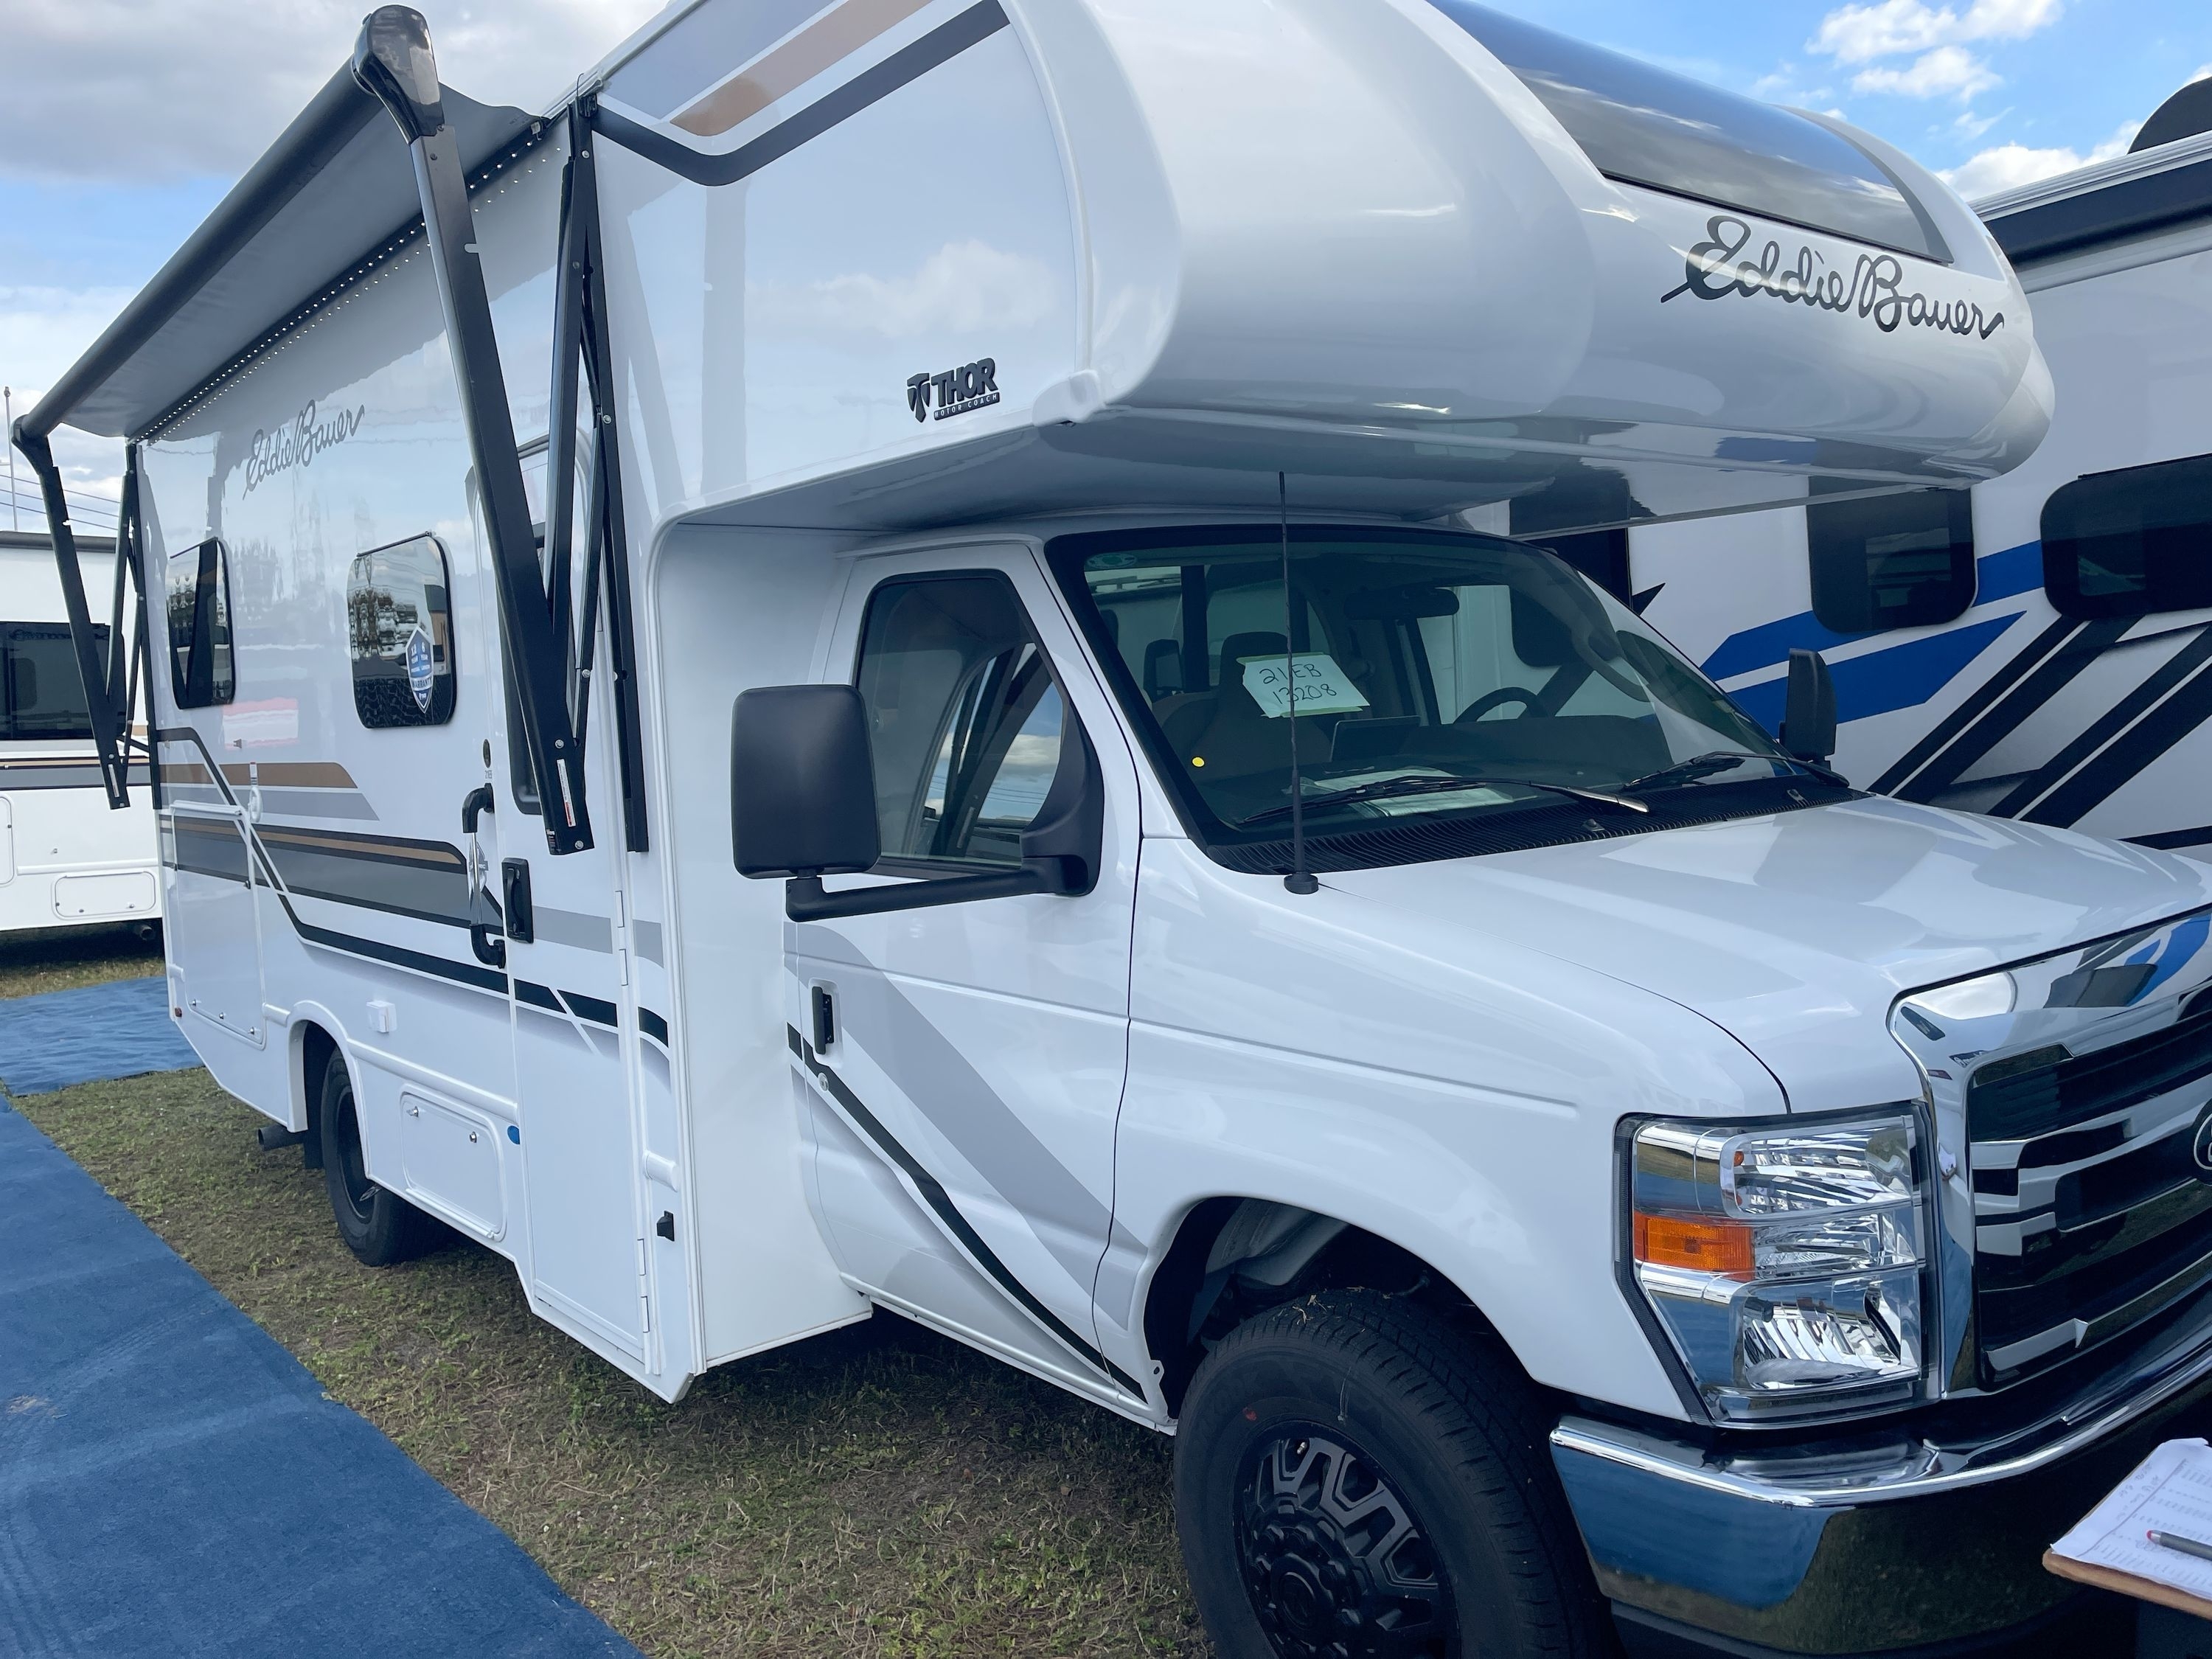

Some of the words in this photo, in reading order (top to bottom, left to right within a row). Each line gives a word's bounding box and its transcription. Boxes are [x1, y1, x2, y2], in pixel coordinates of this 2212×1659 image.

[1660, 215, 1852, 313] Eddie
[1857, 254, 2005, 340] Bauer
[931, 357, 998, 408] THOR
[935, 403, 962, 418] MOTOR
[967, 394, 998, 408] COACH
[243, 426, 295, 501] Eddie
[295, 399, 365, 467] Bauer
[1259, 663, 1321, 684] 21EB
[1272, 683, 1337, 705] 13208
